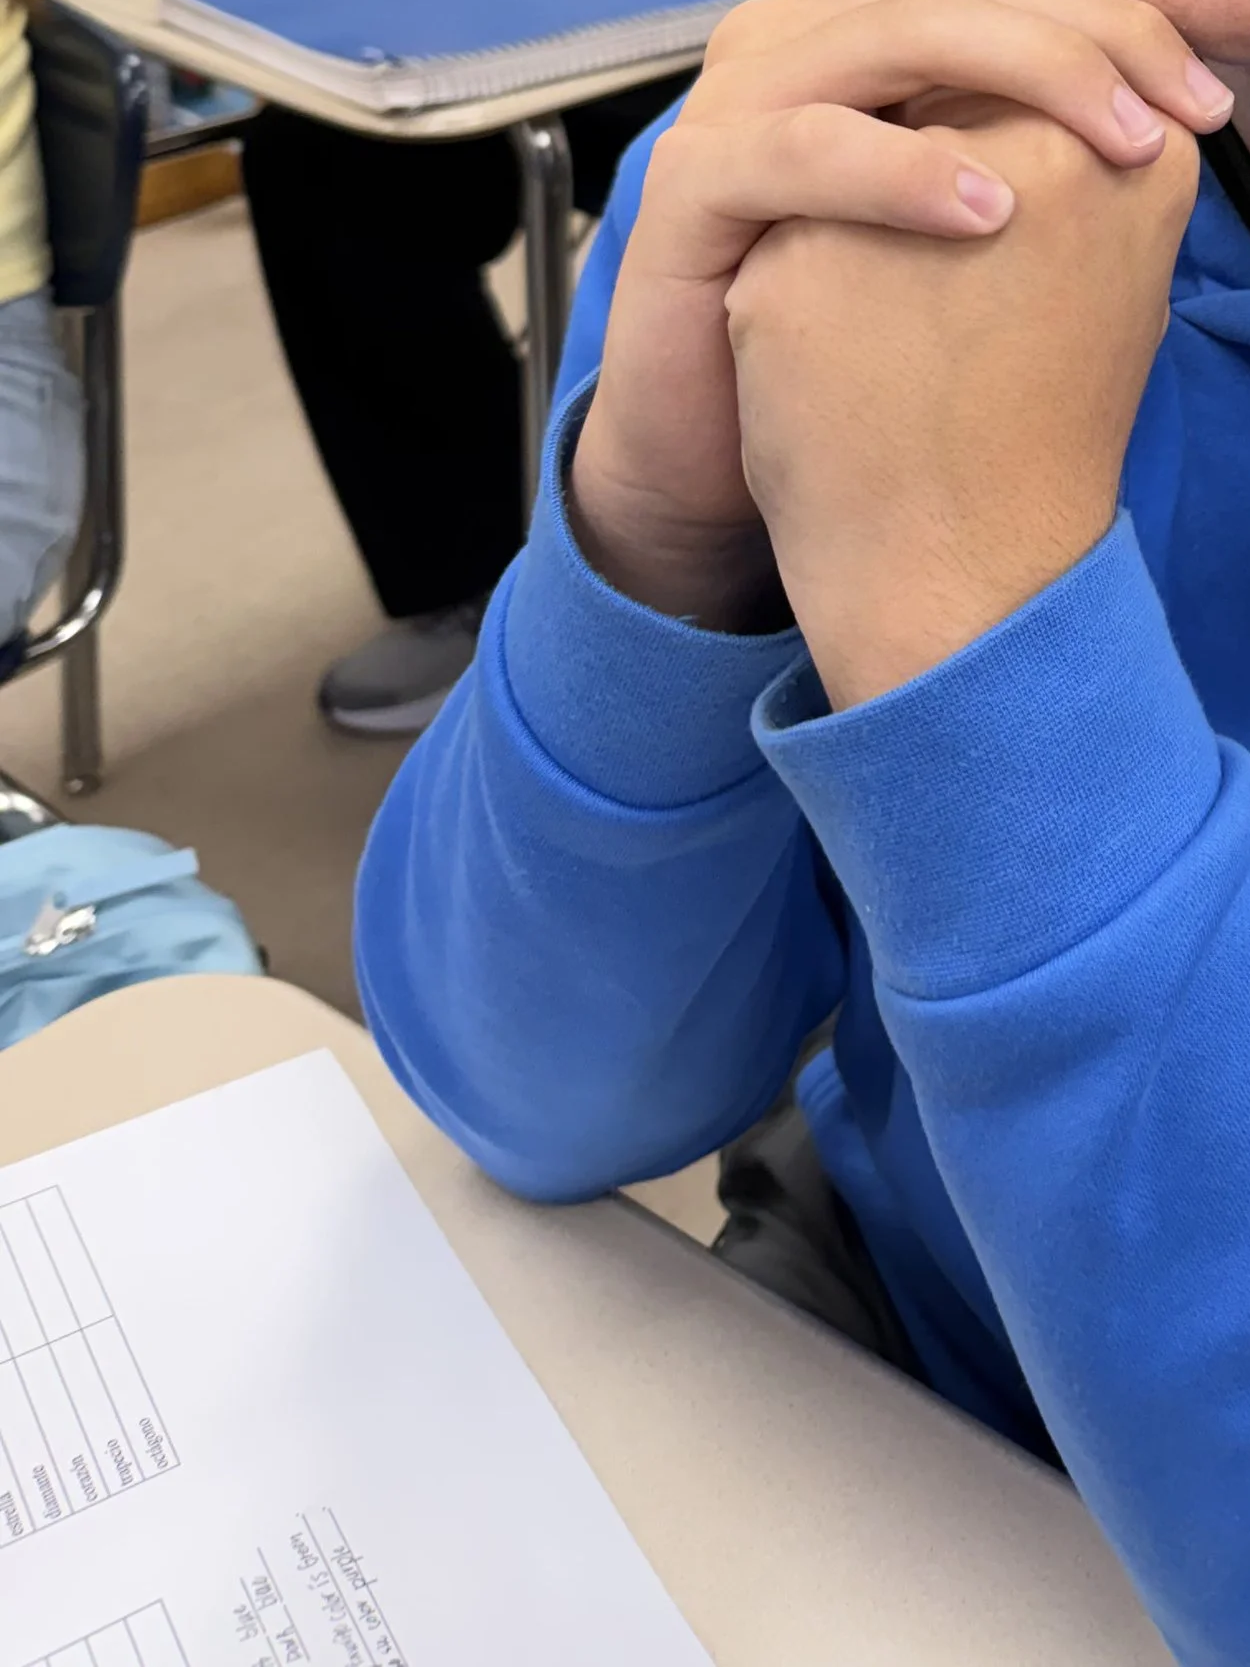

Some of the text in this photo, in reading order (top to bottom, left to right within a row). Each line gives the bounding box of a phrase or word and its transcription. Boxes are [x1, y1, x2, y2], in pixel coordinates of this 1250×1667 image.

[104, 1438, 134, 1487] trapecio
[139, 1417, 169, 1470] octágono
[32, 1464, 62, 1520] diamante
[71, 1454, 99, 1502] corazón
[331, 1545, 378, 1590] purple
